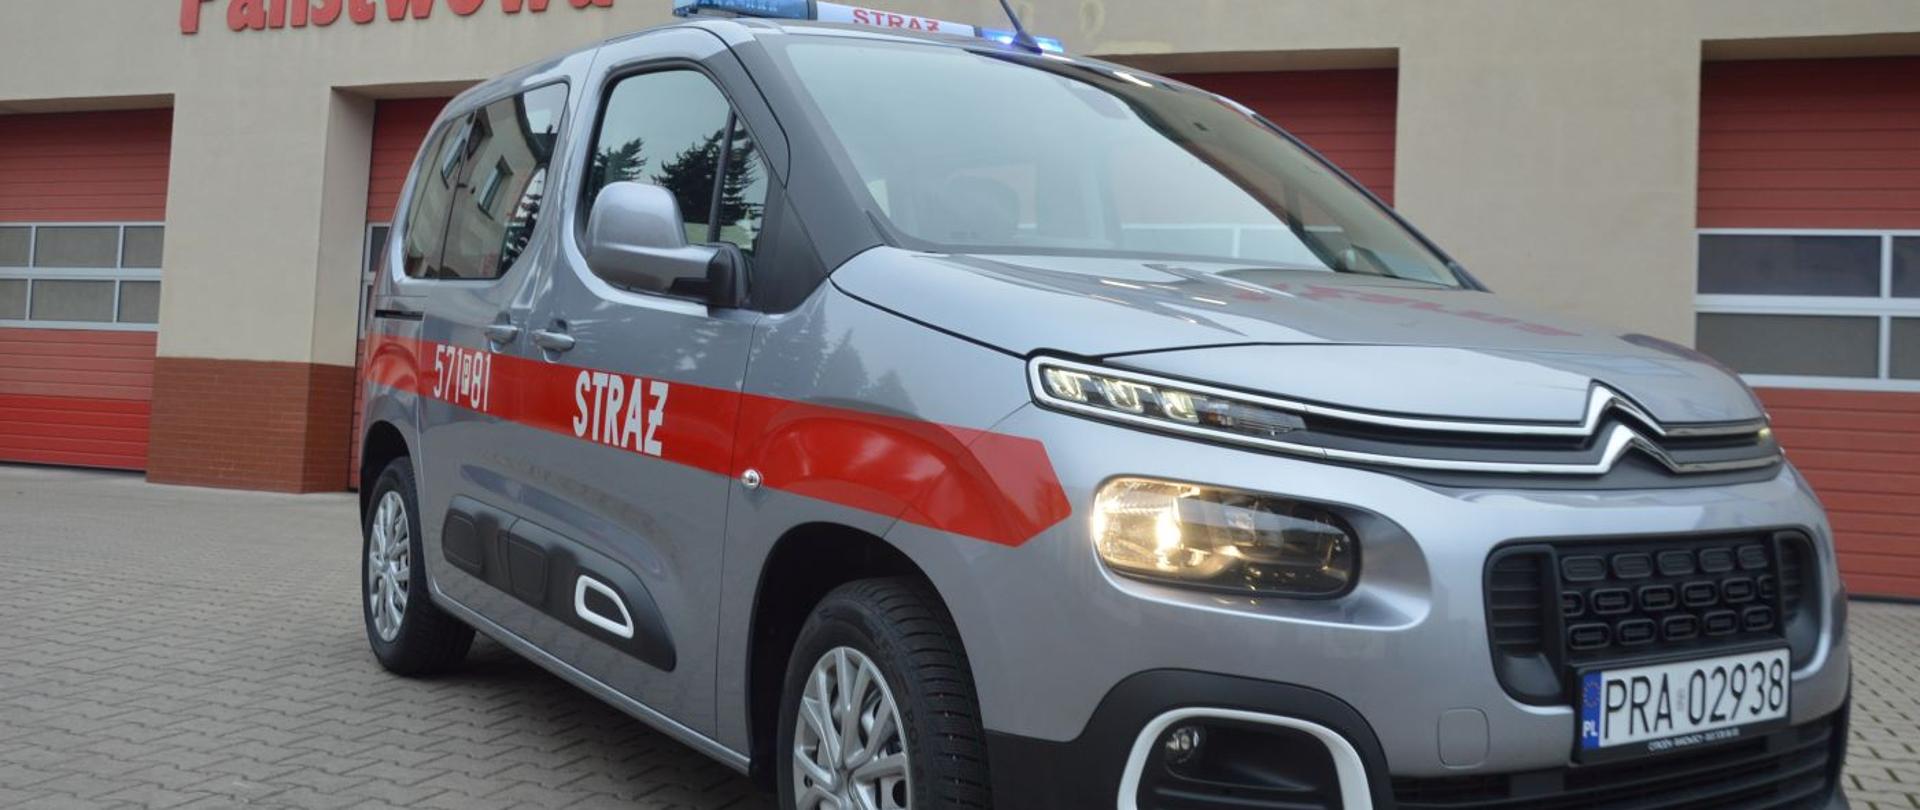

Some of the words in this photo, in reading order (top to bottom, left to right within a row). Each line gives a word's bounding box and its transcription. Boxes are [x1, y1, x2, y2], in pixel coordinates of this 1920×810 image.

[1603, 672, 1673, 740] PRA
[1688, 657, 1785, 726] 02938
[1582, 720, 1599, 738] PL
